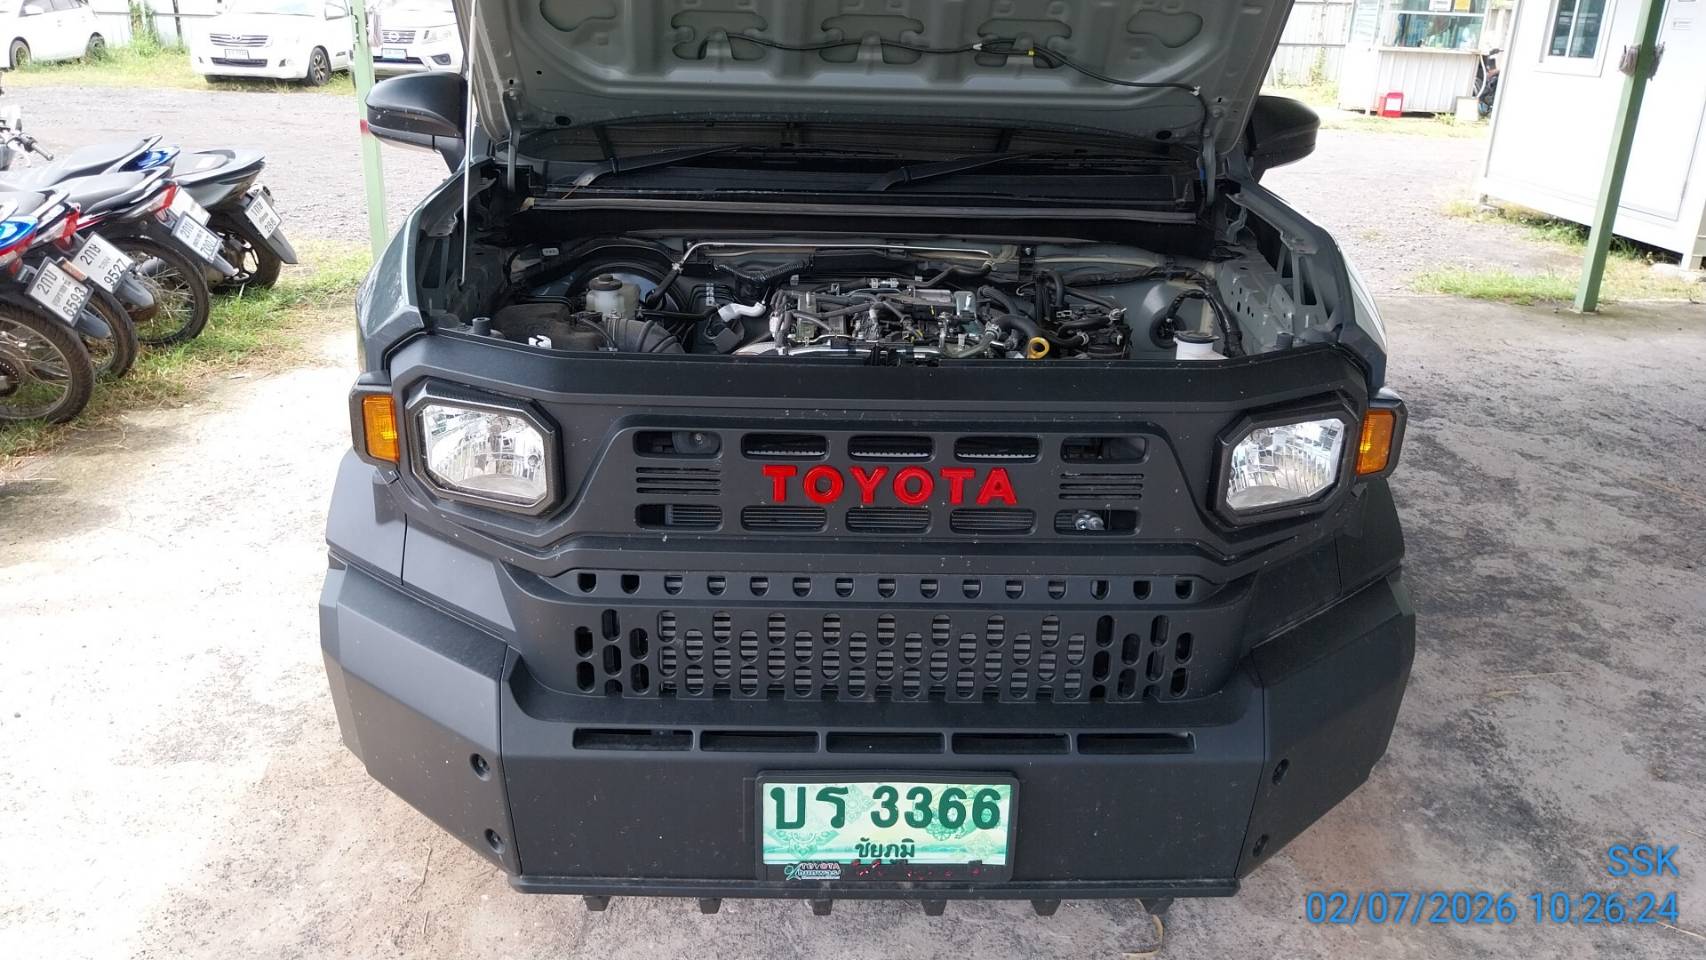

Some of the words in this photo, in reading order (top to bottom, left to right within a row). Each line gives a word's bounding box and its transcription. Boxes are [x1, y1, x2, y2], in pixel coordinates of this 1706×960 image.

[104, 258, 128, 286] 9527
[63, 286, 86, 317] 6593
[763, 464, 1017, 504] TOYOTA
[770, 786, 849, 829] บร
[870, 785, 1001, 830] 3366
